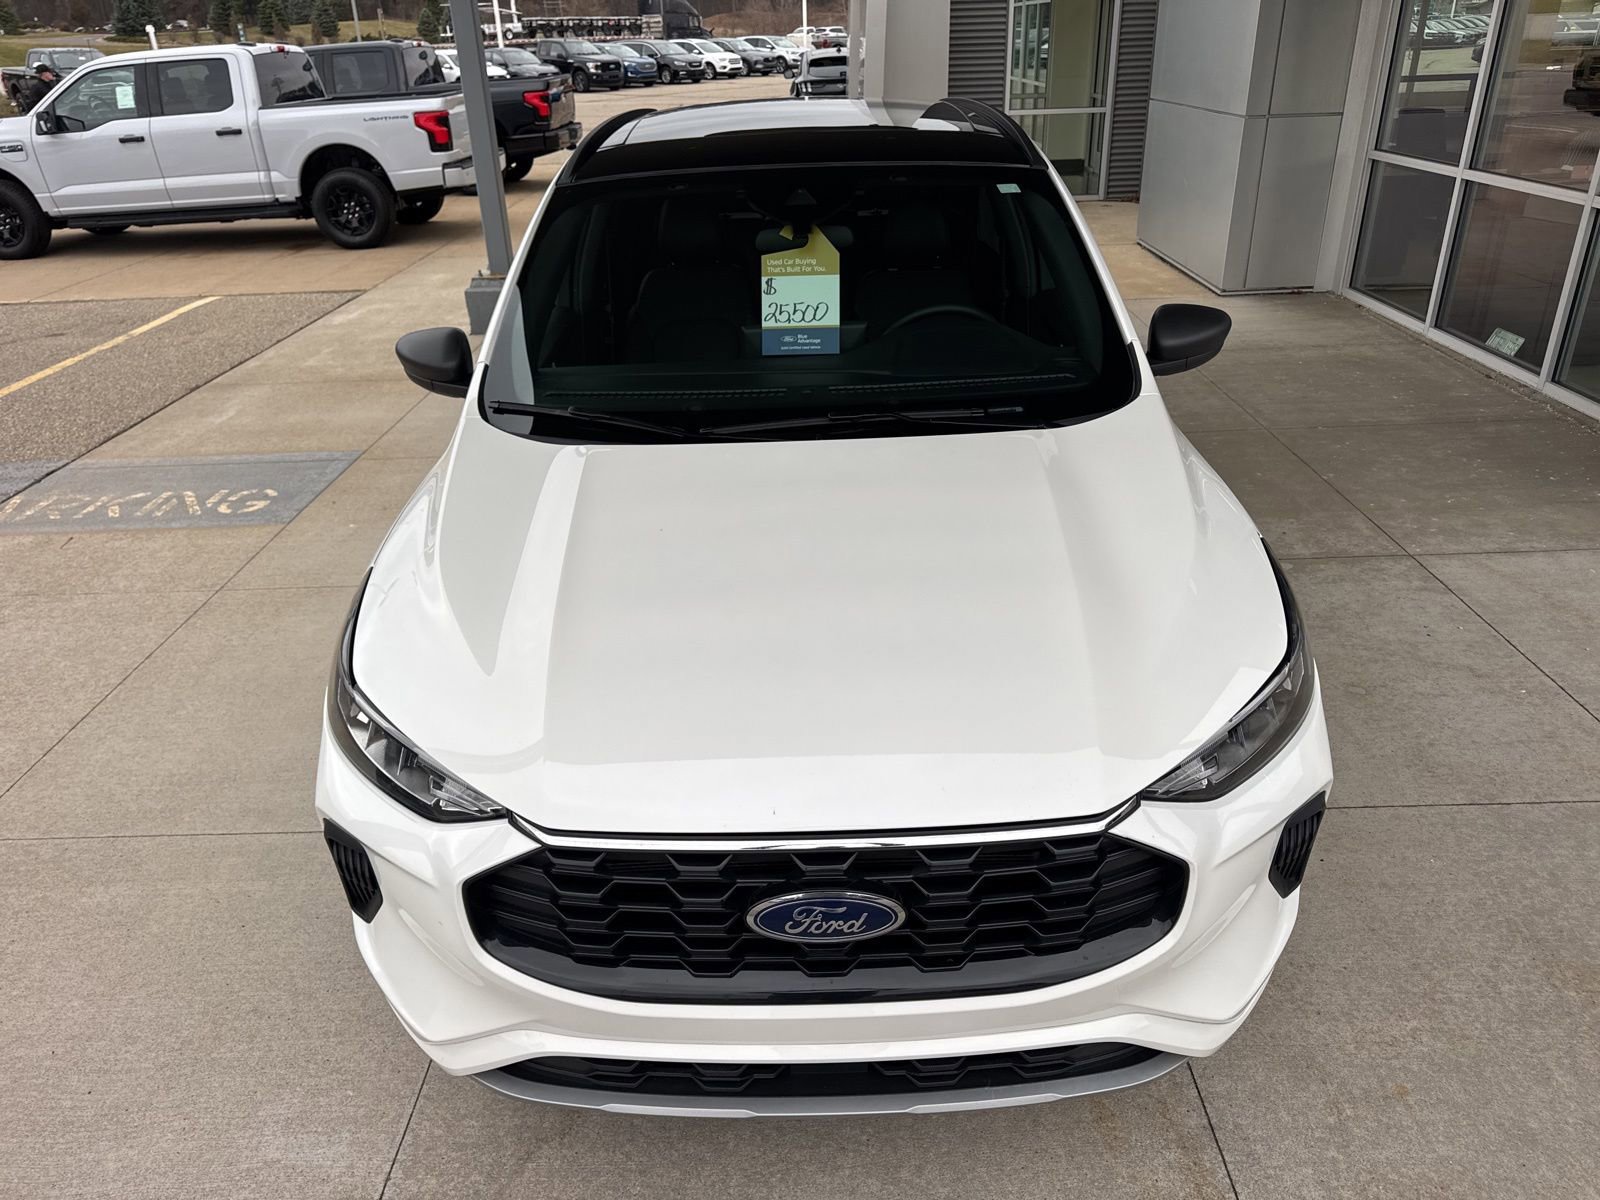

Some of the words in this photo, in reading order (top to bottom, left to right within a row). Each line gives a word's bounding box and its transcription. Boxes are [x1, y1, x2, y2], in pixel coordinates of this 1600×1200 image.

[767, 258, 783, 266] Used
[795, 257, 817, 266] Buying
[784, 906, 869, 934] Ford
